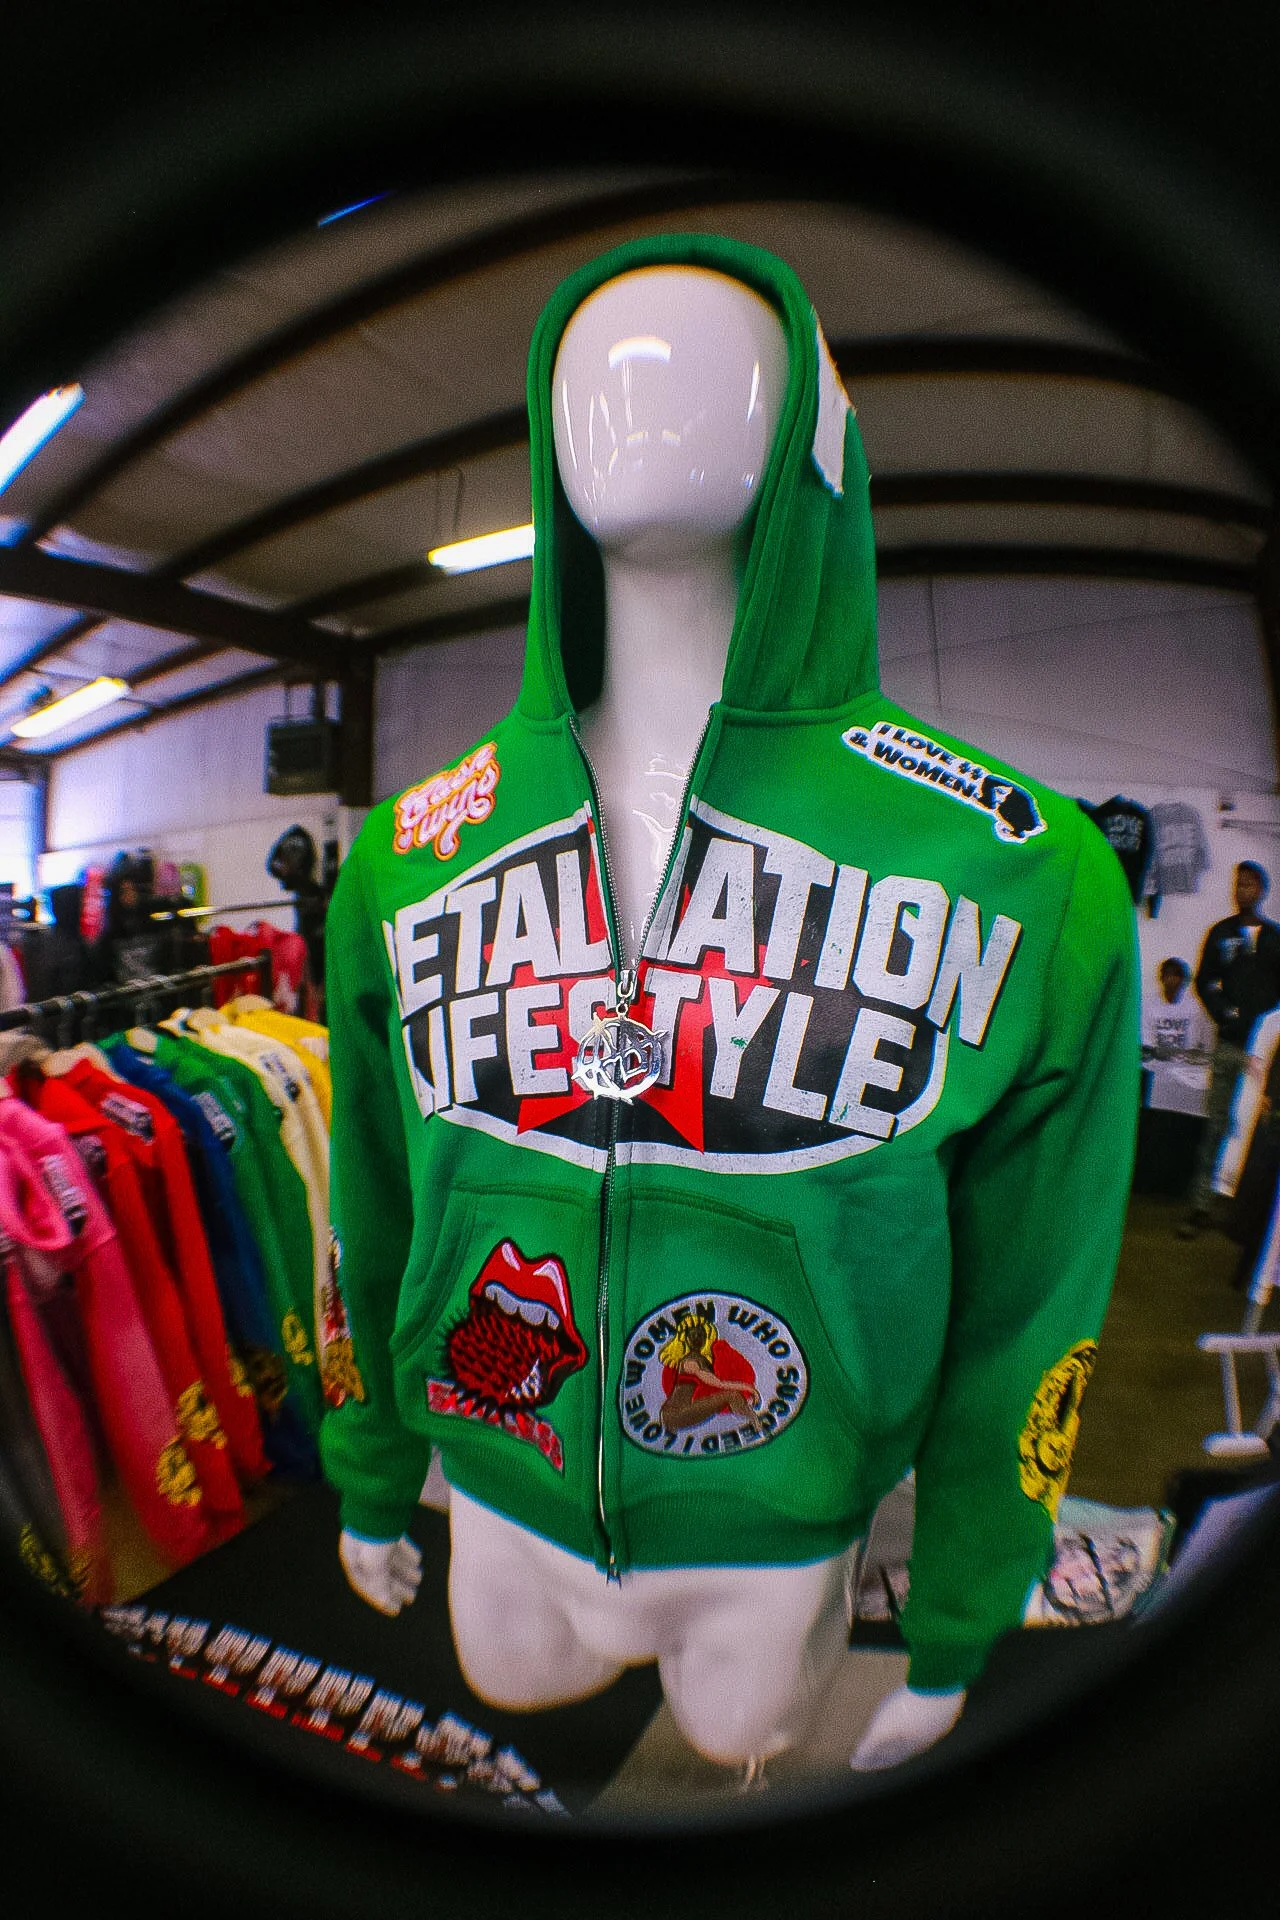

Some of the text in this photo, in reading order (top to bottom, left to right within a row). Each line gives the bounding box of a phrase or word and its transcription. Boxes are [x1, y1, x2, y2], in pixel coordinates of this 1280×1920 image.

[877, 723, 892, 736] I
[892, 728, 957, 766] LOVE
[625, 1300, 716, 1389] WOMEN
[728, 1304, 791, 1360] WHO
[625, 1392, 678, 1450] LOVE
